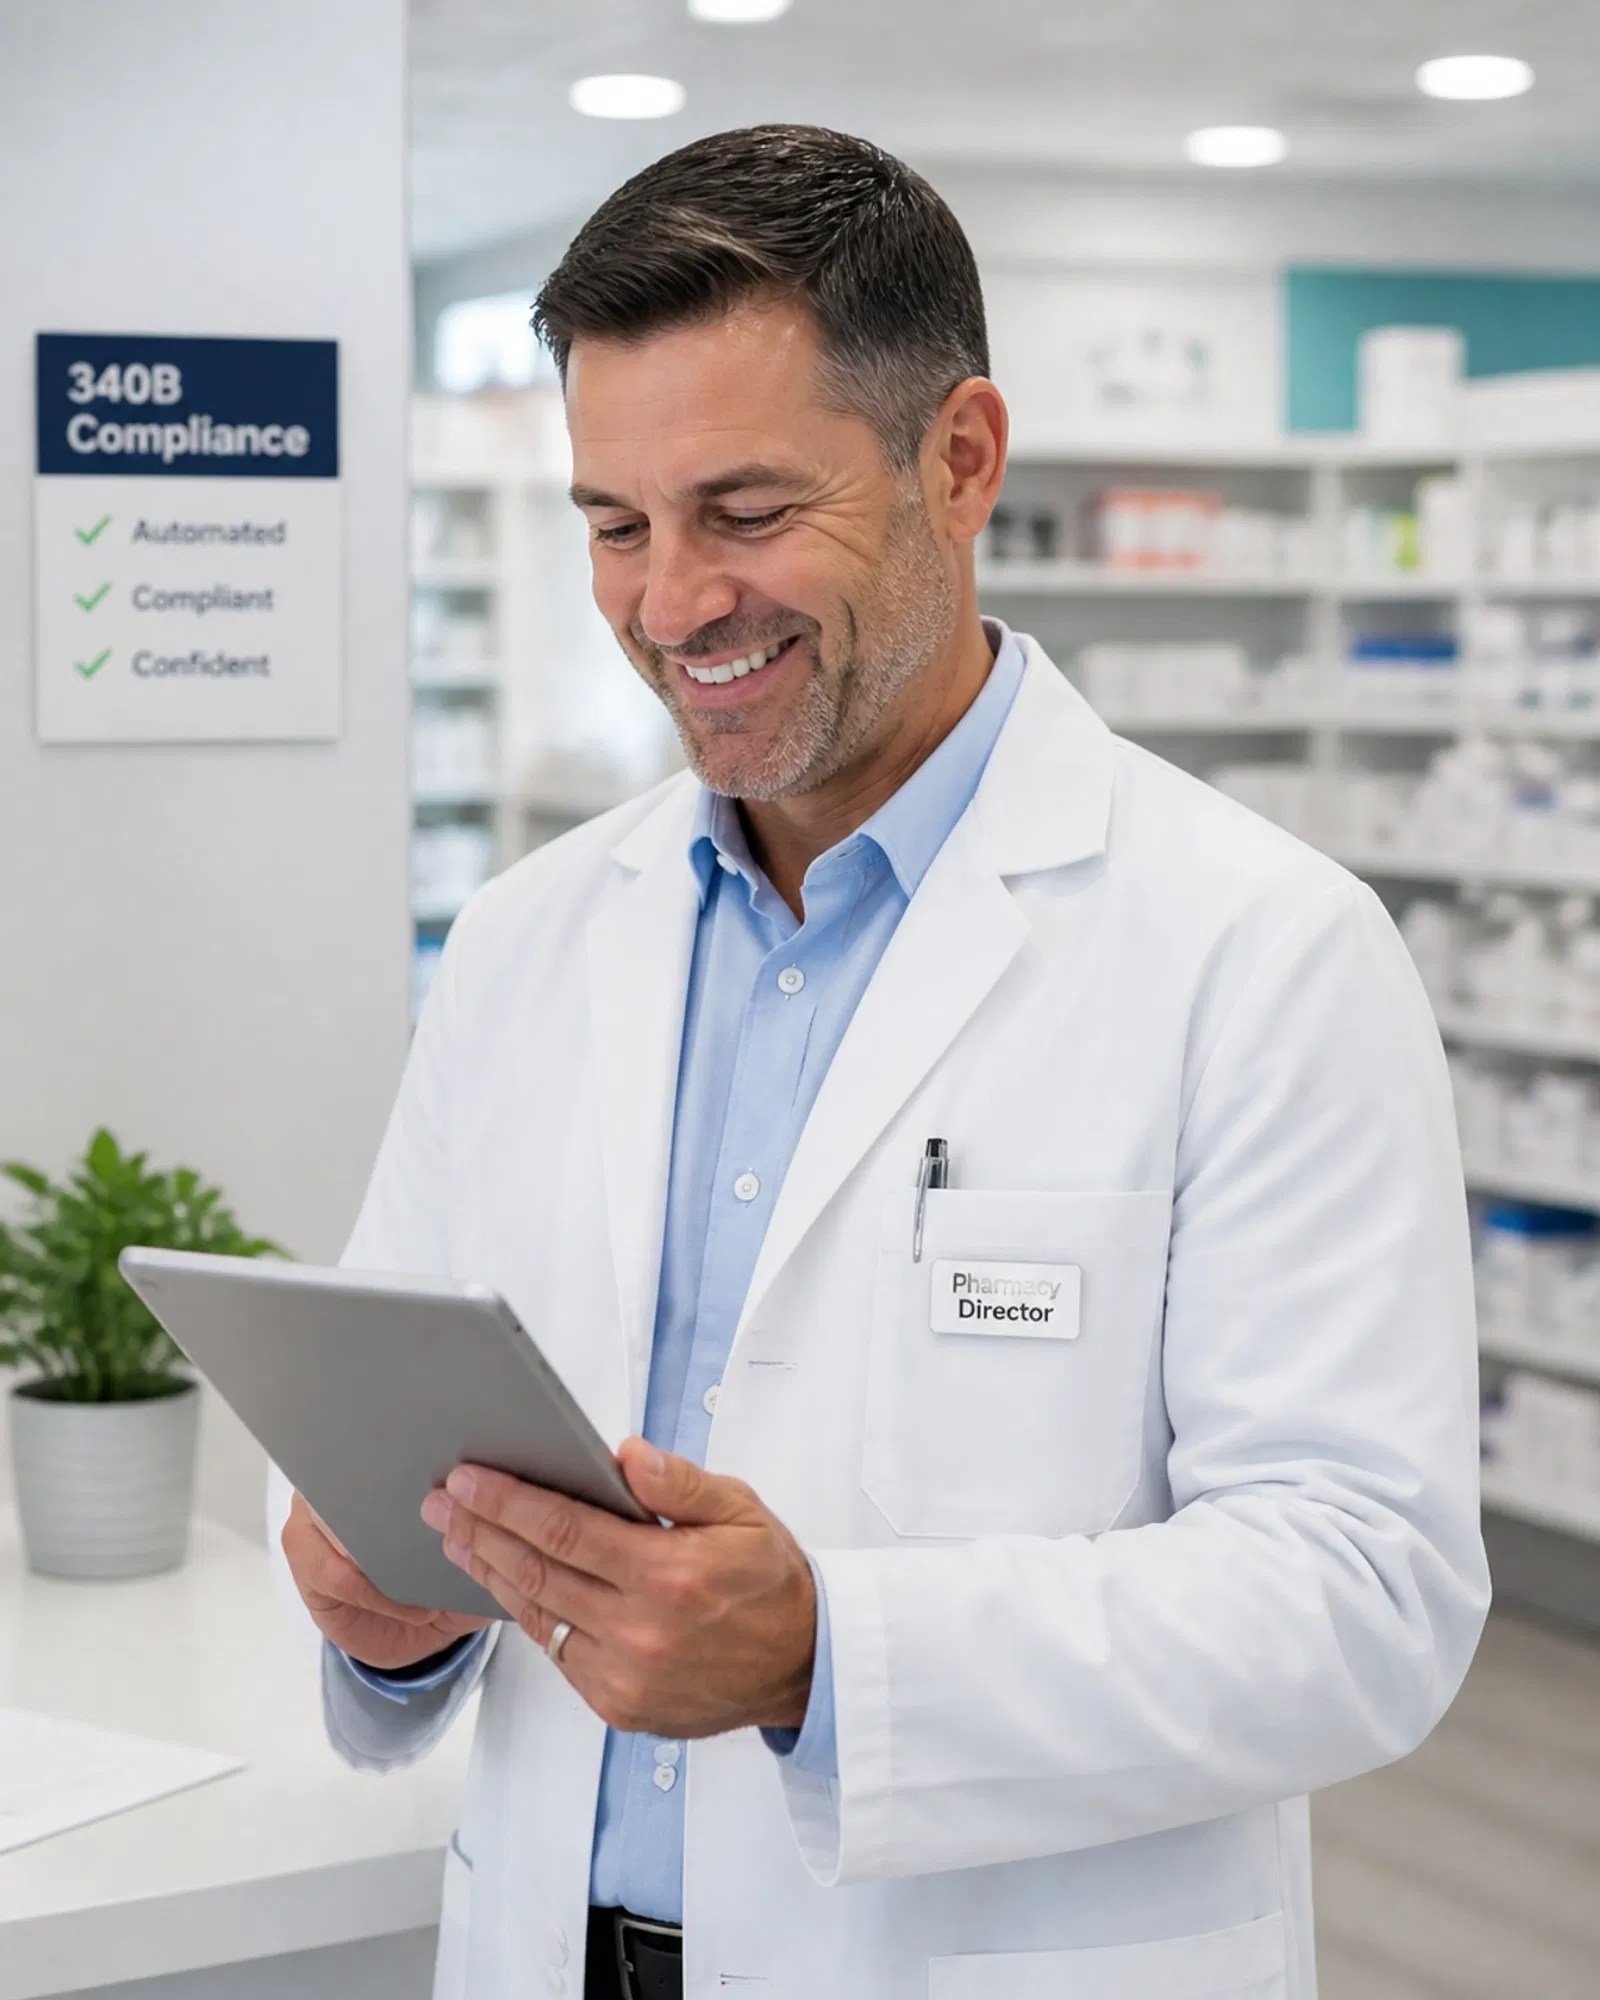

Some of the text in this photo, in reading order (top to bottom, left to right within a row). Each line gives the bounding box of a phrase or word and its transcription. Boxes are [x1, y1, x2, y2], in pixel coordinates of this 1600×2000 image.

[67, 363, 182, 405] 340B
[66, 413, 310, 463] Compliance
[132, 518, 287, 545] Automated
[132, 584, 275, 615] Compliant
[132, 650, 271, 677] Confident
[952, 1272, 1062, 1300] Pharmacy
[958, 1298, 1055, 1323] Director
